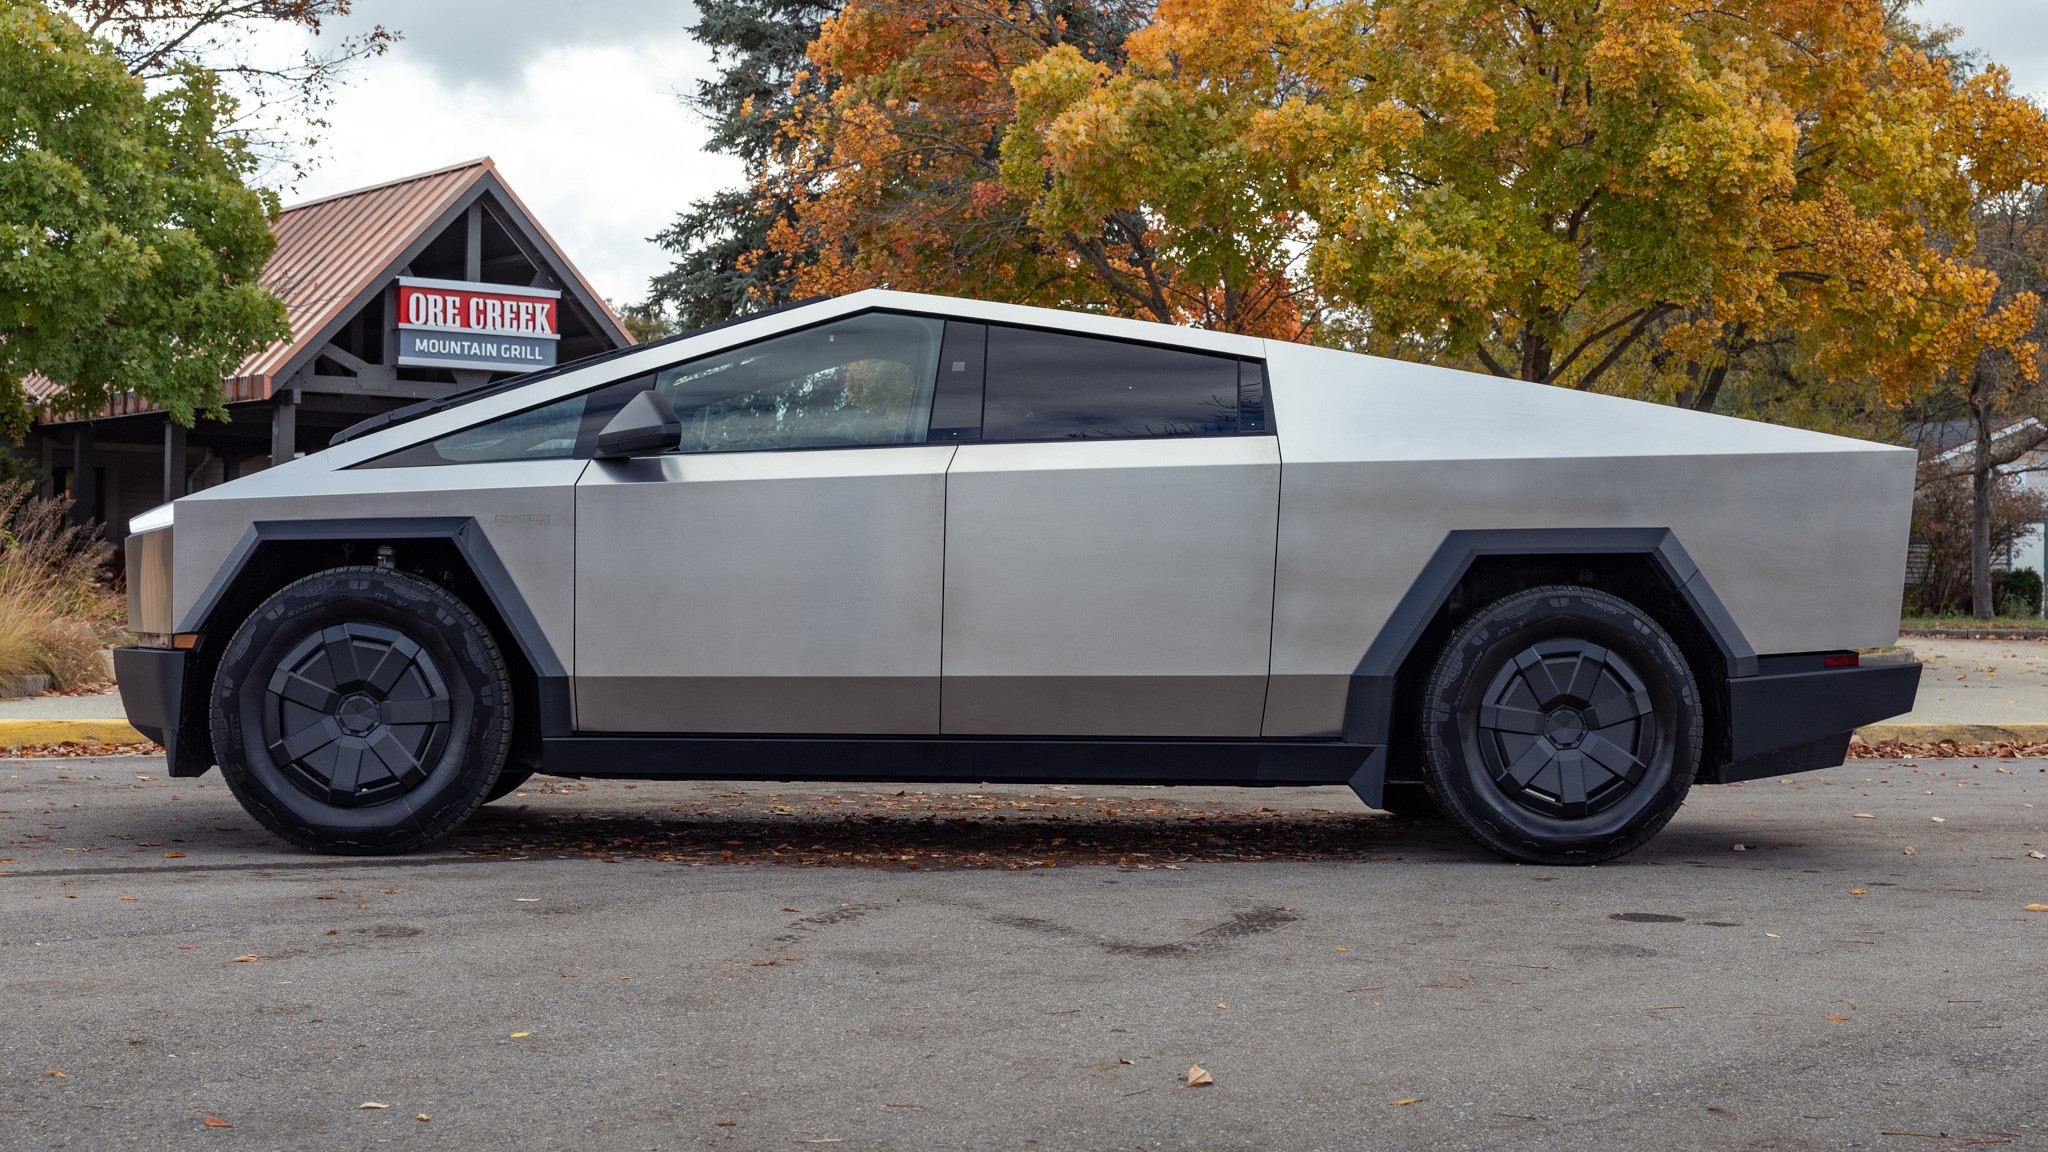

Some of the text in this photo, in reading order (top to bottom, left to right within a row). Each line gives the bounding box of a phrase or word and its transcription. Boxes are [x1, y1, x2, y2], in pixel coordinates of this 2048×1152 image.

[408, 293, 552, 334] ORE CREEK
[415, 338, 543, 360] MOUNTAIN GRILL
